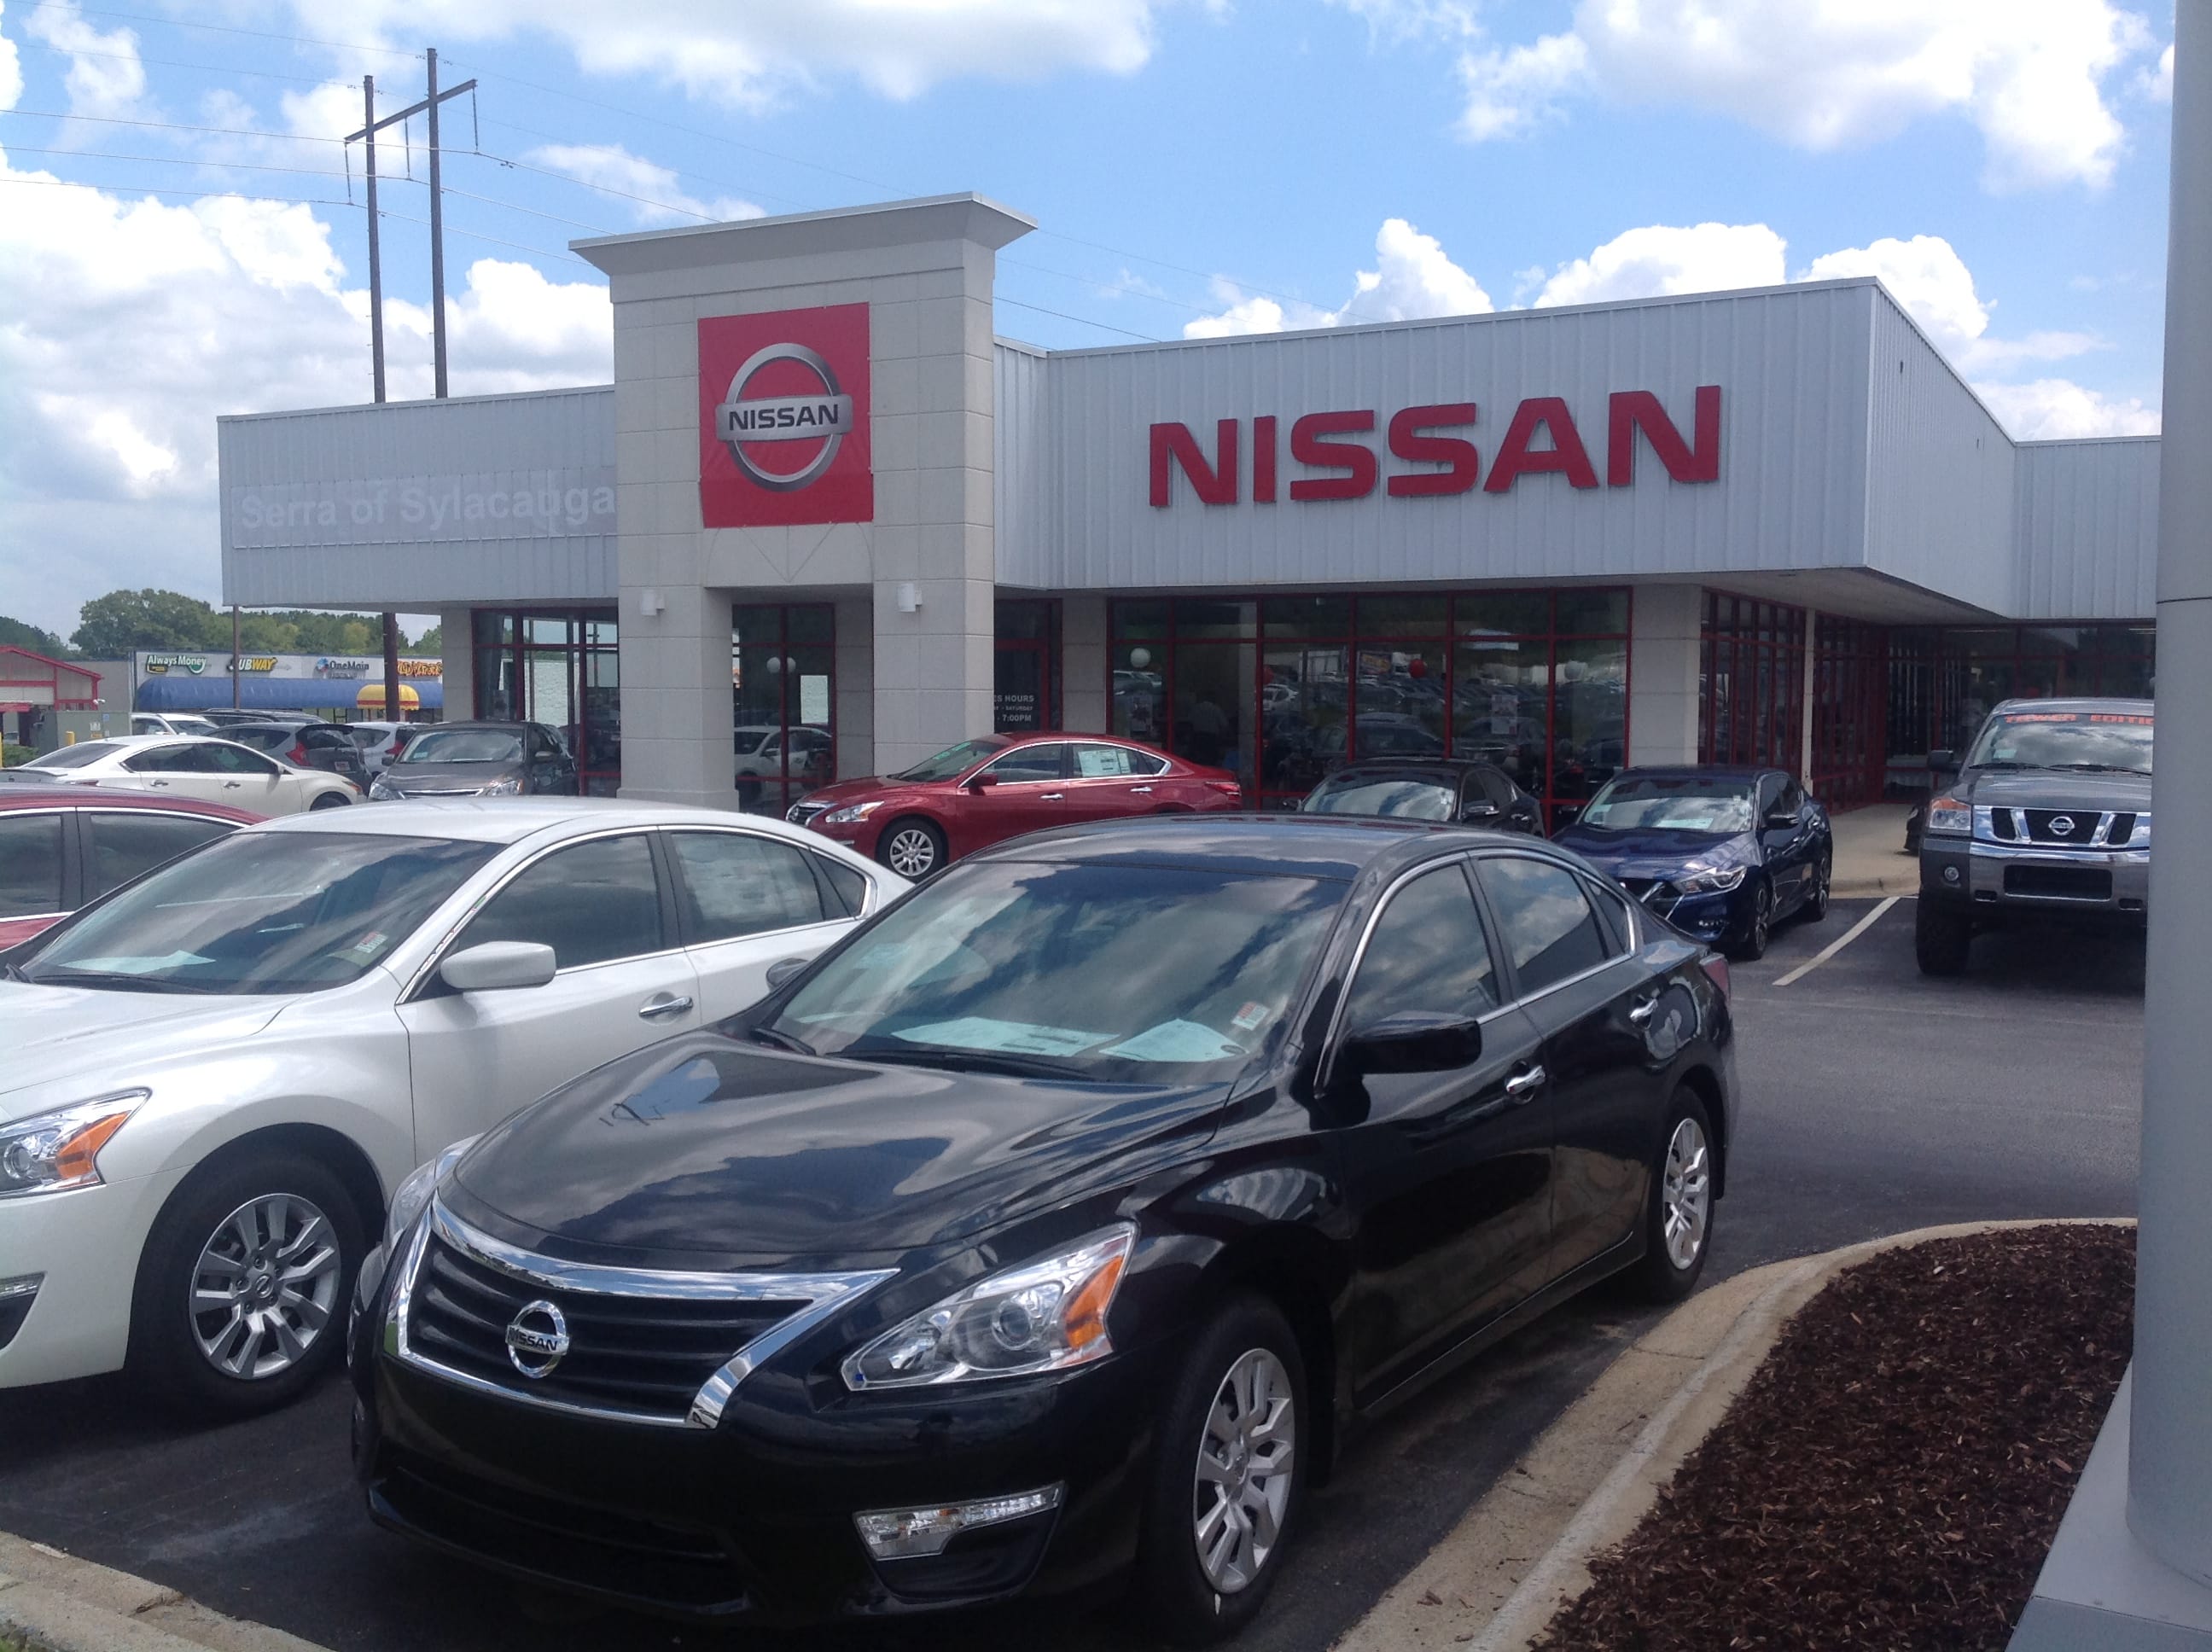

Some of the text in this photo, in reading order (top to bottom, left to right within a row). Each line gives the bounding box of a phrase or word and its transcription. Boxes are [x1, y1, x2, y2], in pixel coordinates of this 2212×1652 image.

[729, 404, 839, 431] NISSAN
[1150, 385, 1720, 507] NISSAN
[241, 485, 615, 531] Serra of Sylacauga
[148, 654, 178, 667] Always
[178, 654, 207, 669] Money
[229, 657, 277, 671] UBWAY
[329, 660, 370, 671] OneMain
